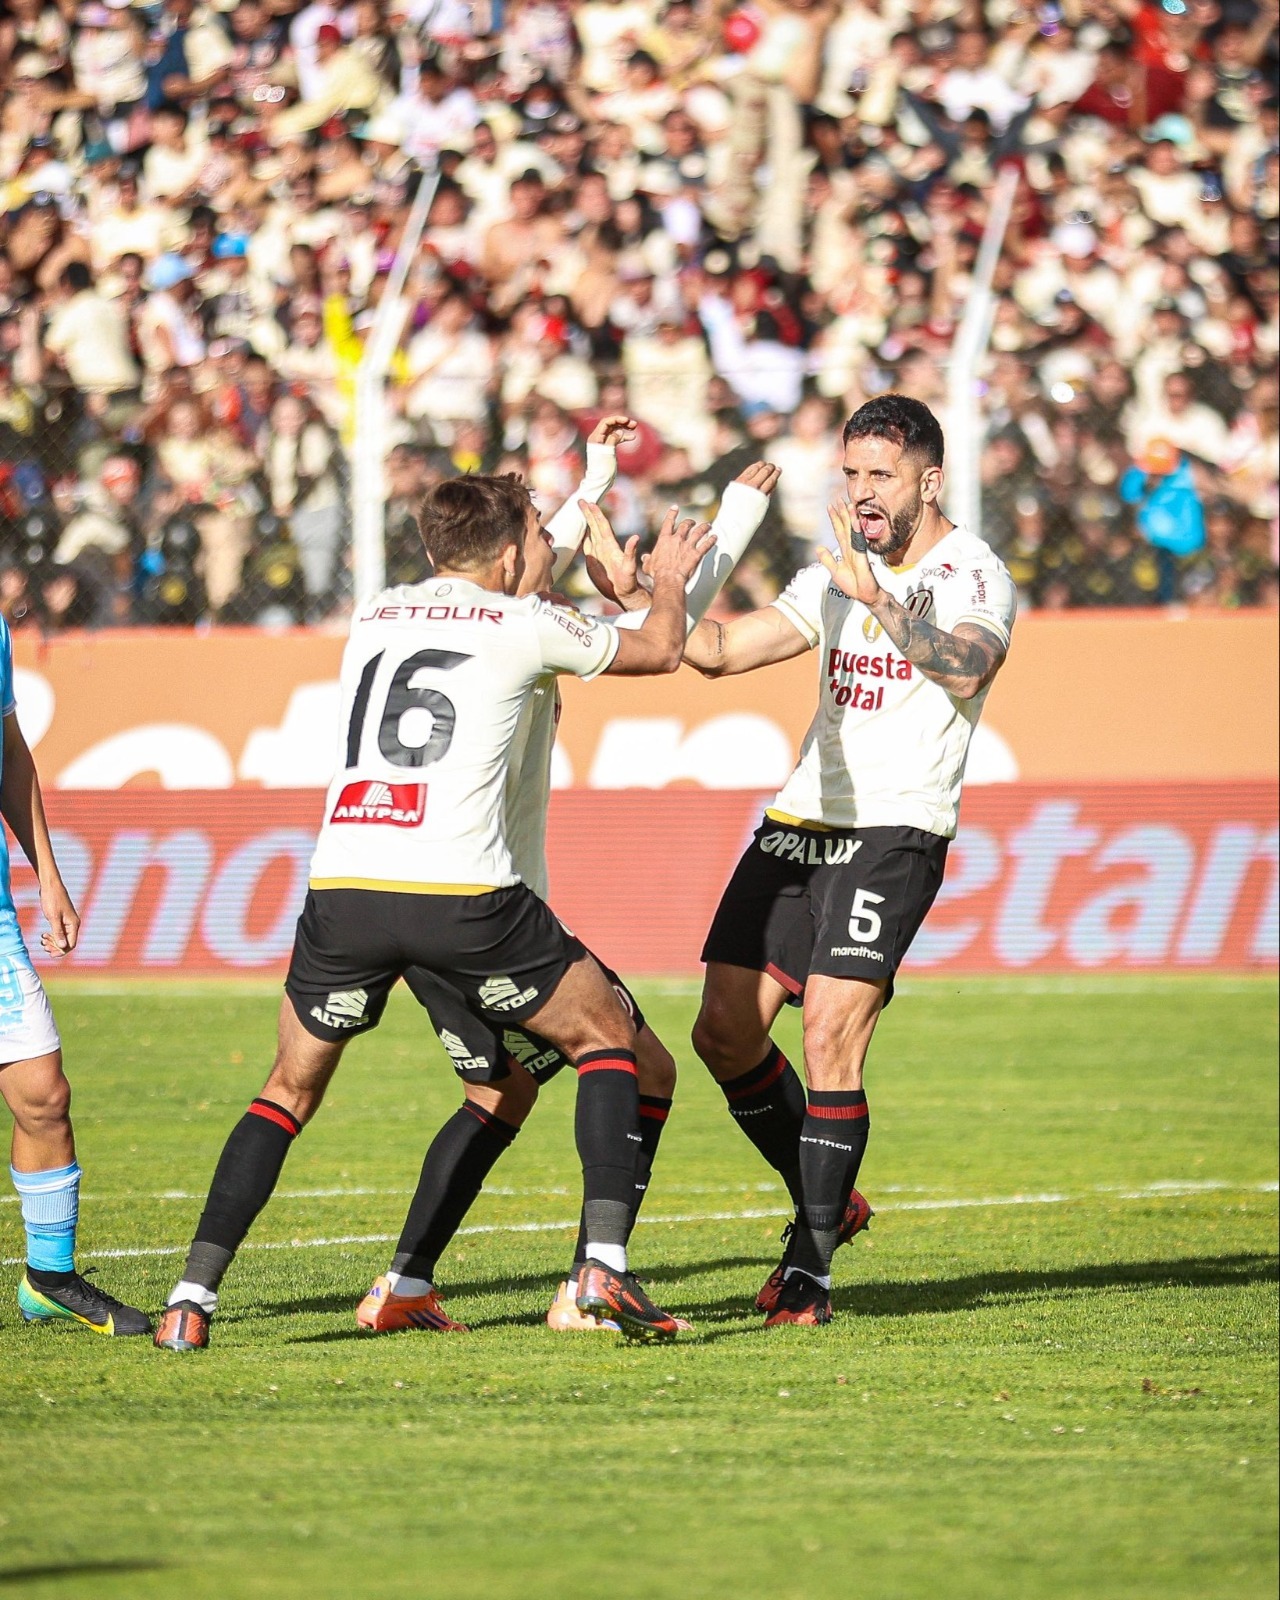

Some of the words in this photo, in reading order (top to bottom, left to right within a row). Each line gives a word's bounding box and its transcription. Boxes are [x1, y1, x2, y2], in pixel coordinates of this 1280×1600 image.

[360, 605, 504, 625] JETOUR
[828, 648, 913, 681] puesta
[345, 648, 476, 770] 16
[829, 678, 885, 712] total
[334, 805, 419, 823] ANYPSA
[759, 830, 863, 866] OPALUX
[896, 799, 1279, 967] etan
[848, 887, 886, 943] 5
[830, 946, 885, 963] marathon
[523, 1049, 561, 1075] TOS
